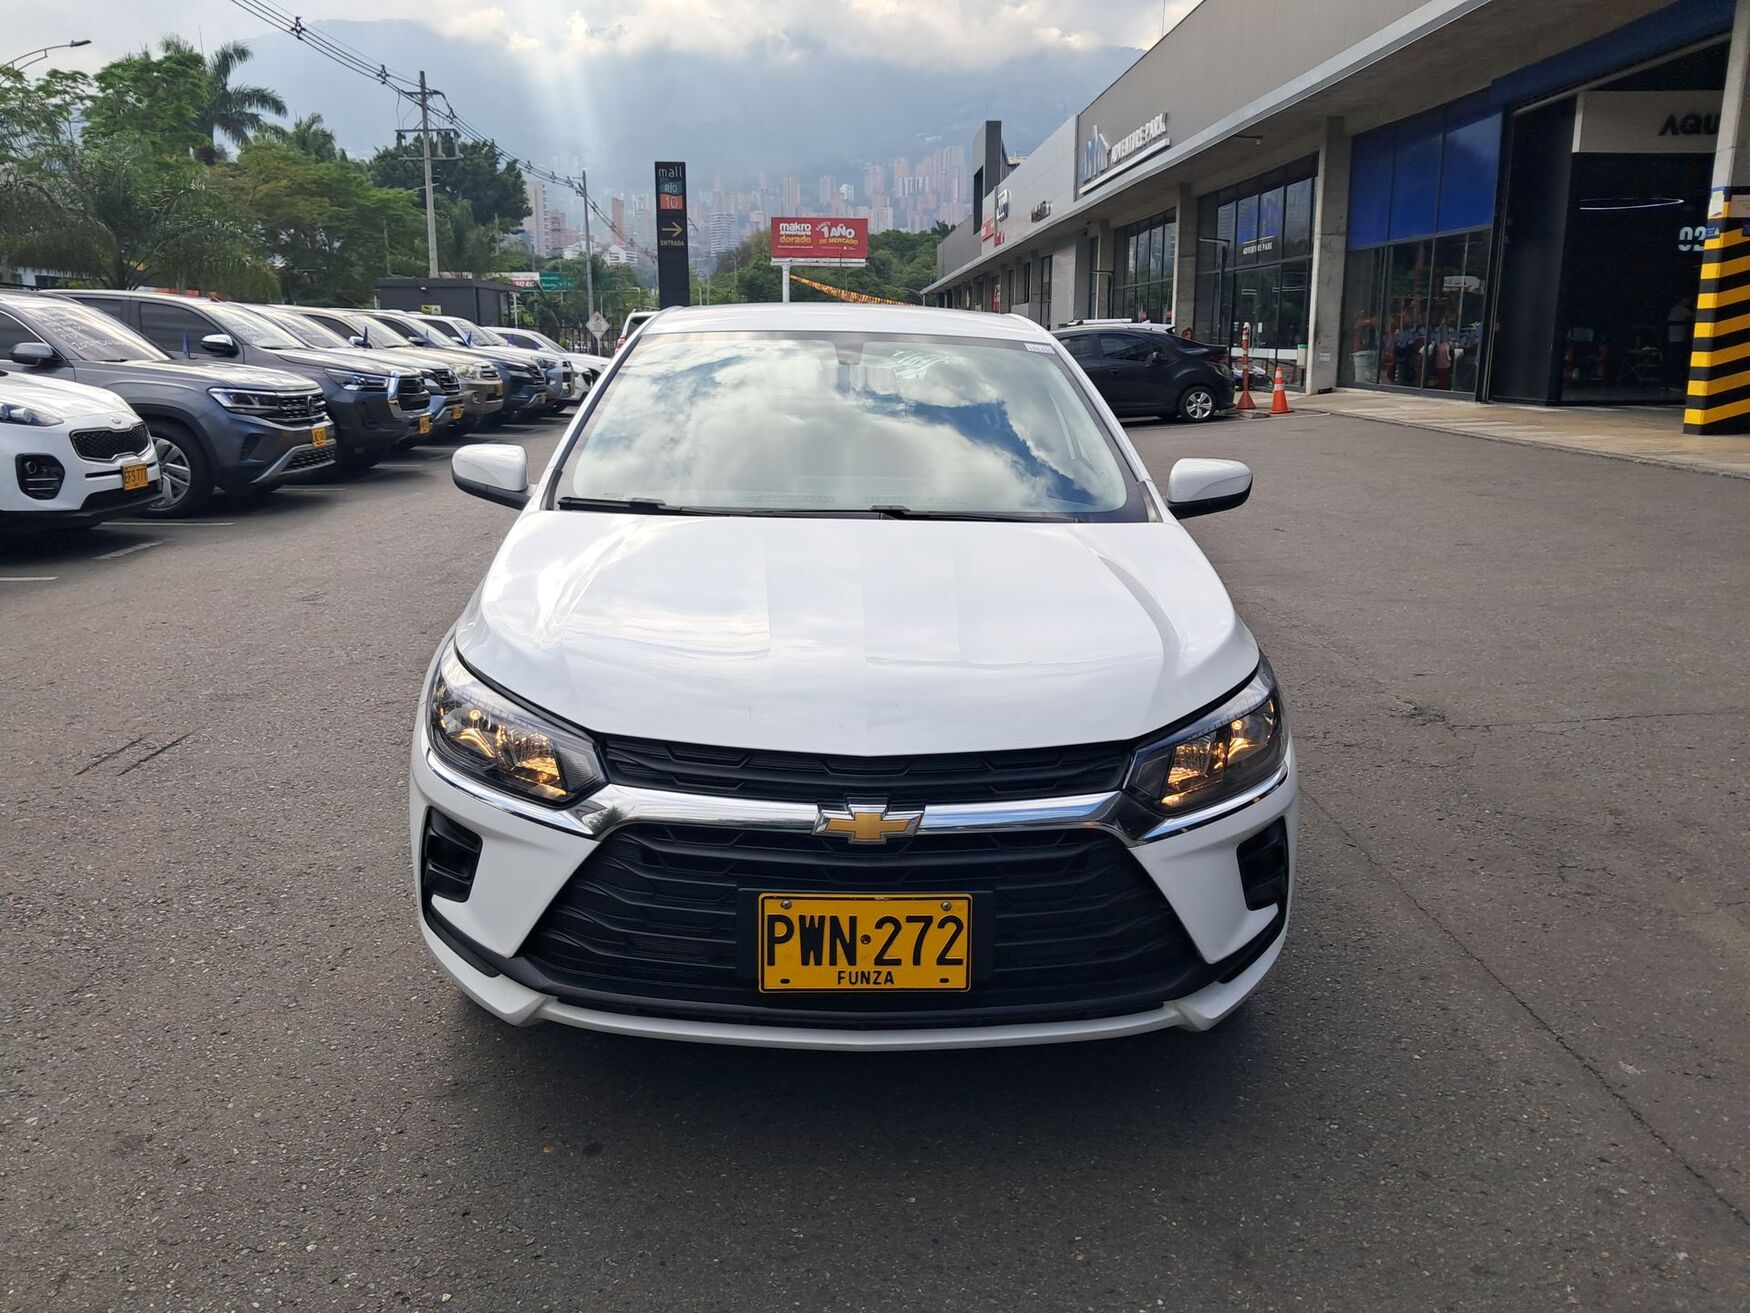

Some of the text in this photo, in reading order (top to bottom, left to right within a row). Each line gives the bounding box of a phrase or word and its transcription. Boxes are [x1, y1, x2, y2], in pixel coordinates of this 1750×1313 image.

[658, 166, 682, 178] mall
[779, 222, 812, 231] makro
[820, 226, 829, 238] 1
[830, 223, 856, 239] AÑO
[779, 235, 812, 244] dorado
[1678, 226, 1706, 252] 02
[837, 970, 895, 985] FUNZA
